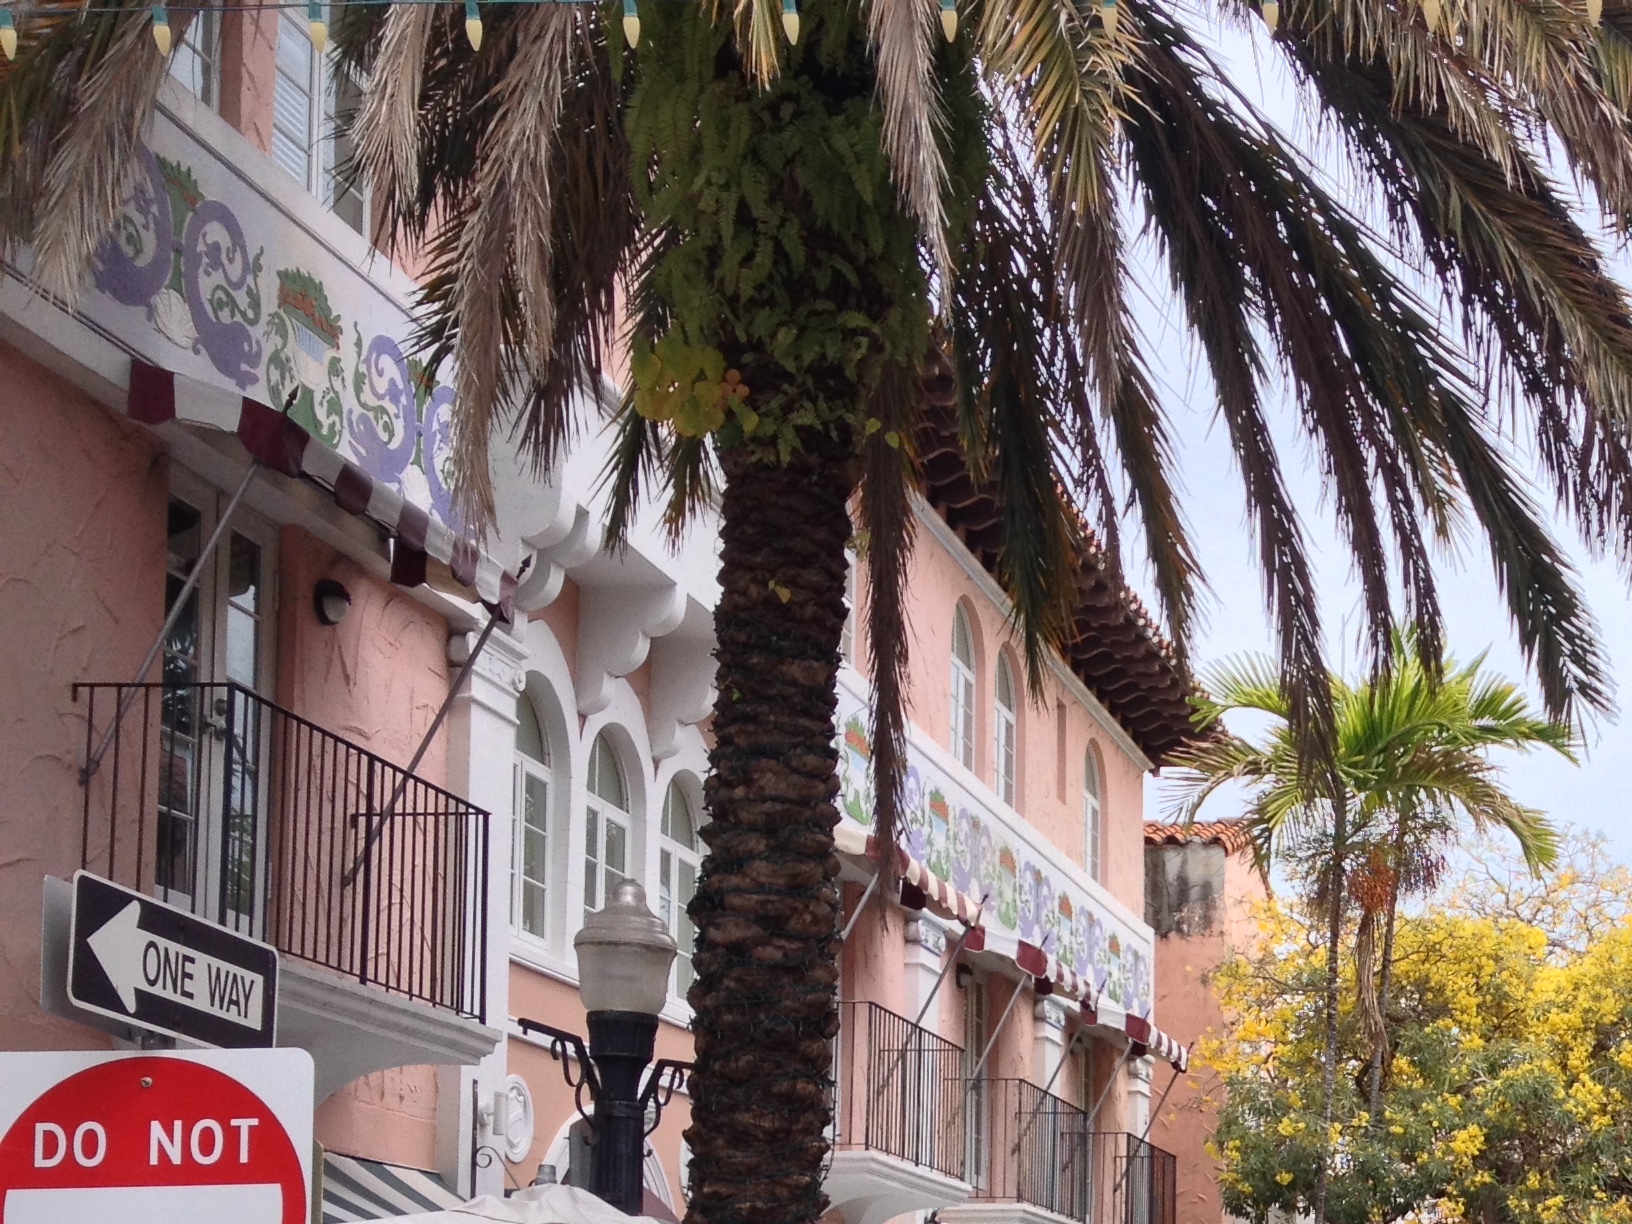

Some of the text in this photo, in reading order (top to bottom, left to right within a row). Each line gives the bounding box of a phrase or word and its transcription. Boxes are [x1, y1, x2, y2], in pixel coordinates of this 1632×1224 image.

[143, 940, 255, 1020] ONE WAY
[34, 1118, 260, 1168] DO NOT
